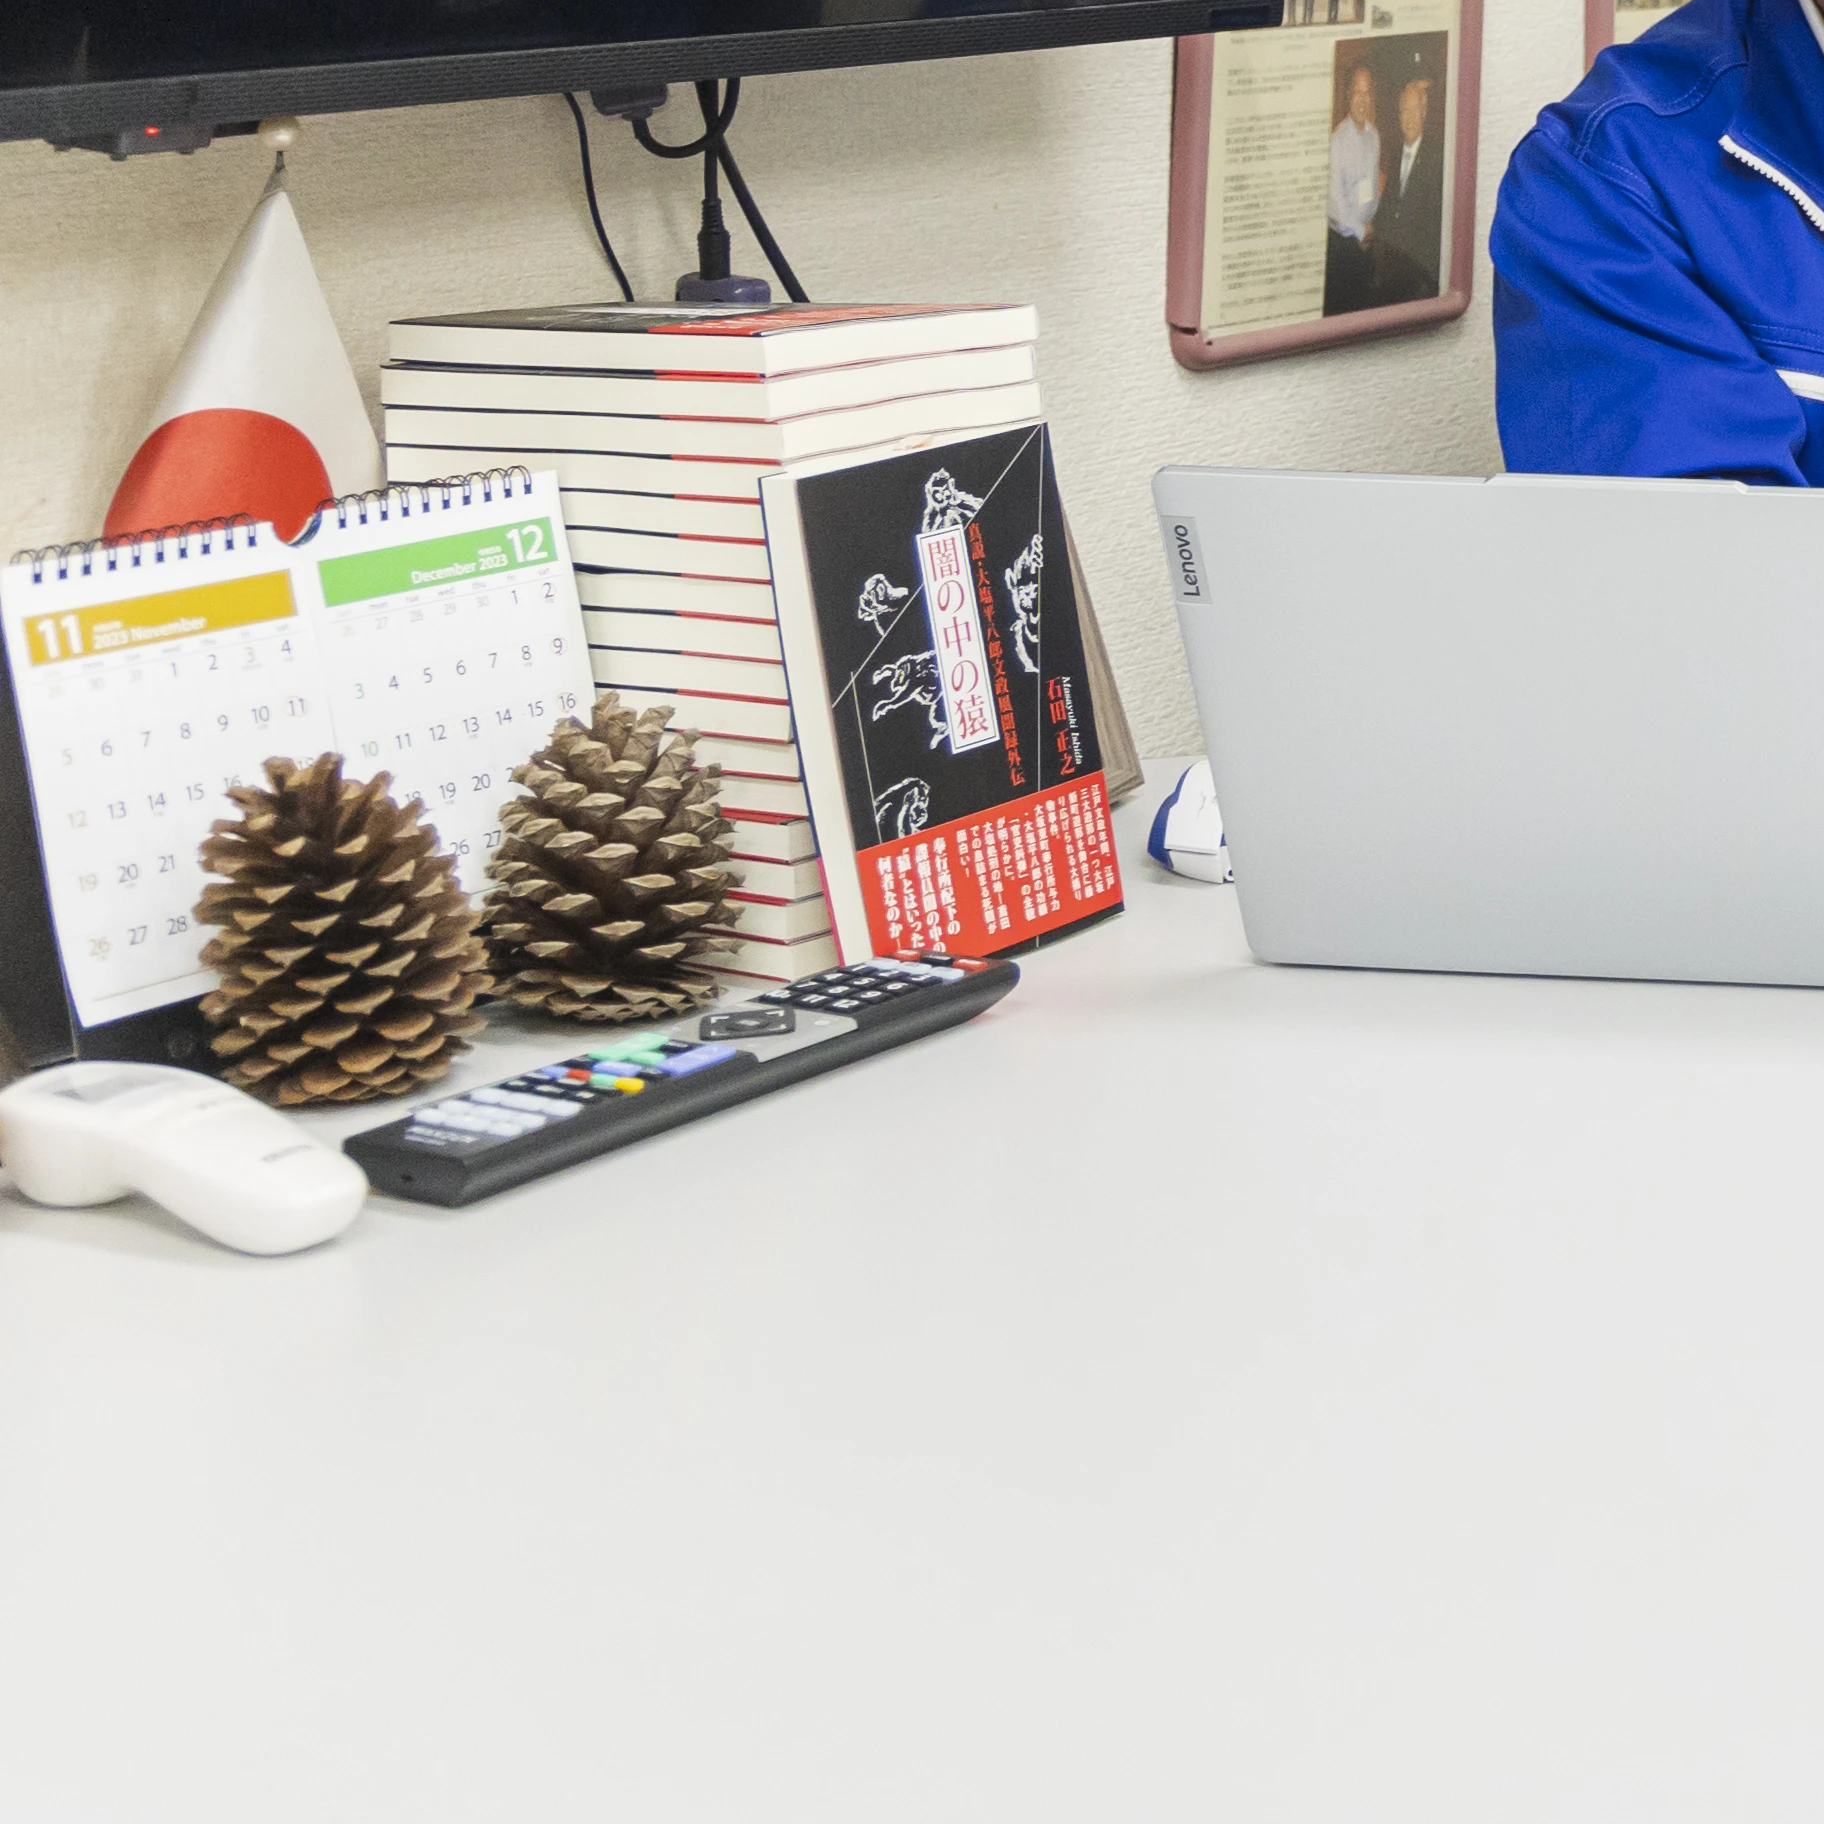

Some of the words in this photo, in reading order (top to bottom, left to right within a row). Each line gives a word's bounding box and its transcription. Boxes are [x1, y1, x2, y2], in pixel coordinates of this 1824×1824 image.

[411, 563, 477, 585] December
[479, 555, 508, 571] 2023
[506, 525, 548, 564] 12
[1174, 524, 1201, 597] Lenovo
[511, 589, 518, 604] 1
[543, 582, 555, 598] 2
[38, 614, 83, 660] 11
[170, 662, 178, 678] 1
[208, 654, 219, 671] 2
[281, 639, 292, 655] 4
[928, 537, 989, 739] 闇の中の猿
[355, 683, 364, 699] 3
[388, 676, 399, 690] 4
[423, 668, 433, 684] 5
[456, 660, 466, 675] 6
[488, 653, 497, 668] 7
[521, 645, 531, 660] 8
[553, 638, 563, 654] 9
[1046, 678, 1067, 724] 石田
[1061, 677, 1080, 728] Masayuki
[1071, 732, 1083, 766] Ishida
[101, 740, 113, 757] 6
[141, 731, 151, 748] 7
[180, 722, 192, 739] 8
[217, 715, 229, 731] 9
[251, 706, 270, 723] 10
[288, 698, 306, 717] 11
[361, 741, 379, 757] 10
[395, 733, 411, 749] 11
[429, 725, 447, 741] 12
[463, 717, 480, 734] 13
[495, 709, 512, 726] 14
[528, 701, 544, 717] 15
[559, 693, 576, 710] 16
[1056, 729, 1076, 776] 正之
[108, 801, 127, 819] 13
[148, 792, 166, 811] 14
[186, 783, 205, 802] 15
[439, 782, 456, 799] 19
[471, 774, 491, 791] 20
[484, 830, 503, 848] 27
[118, 863, 139, 884] 20
[158, 855, 176, 873] 21
[127, 926, 147, 946] 27
[166, 916, 188, 936] 28
